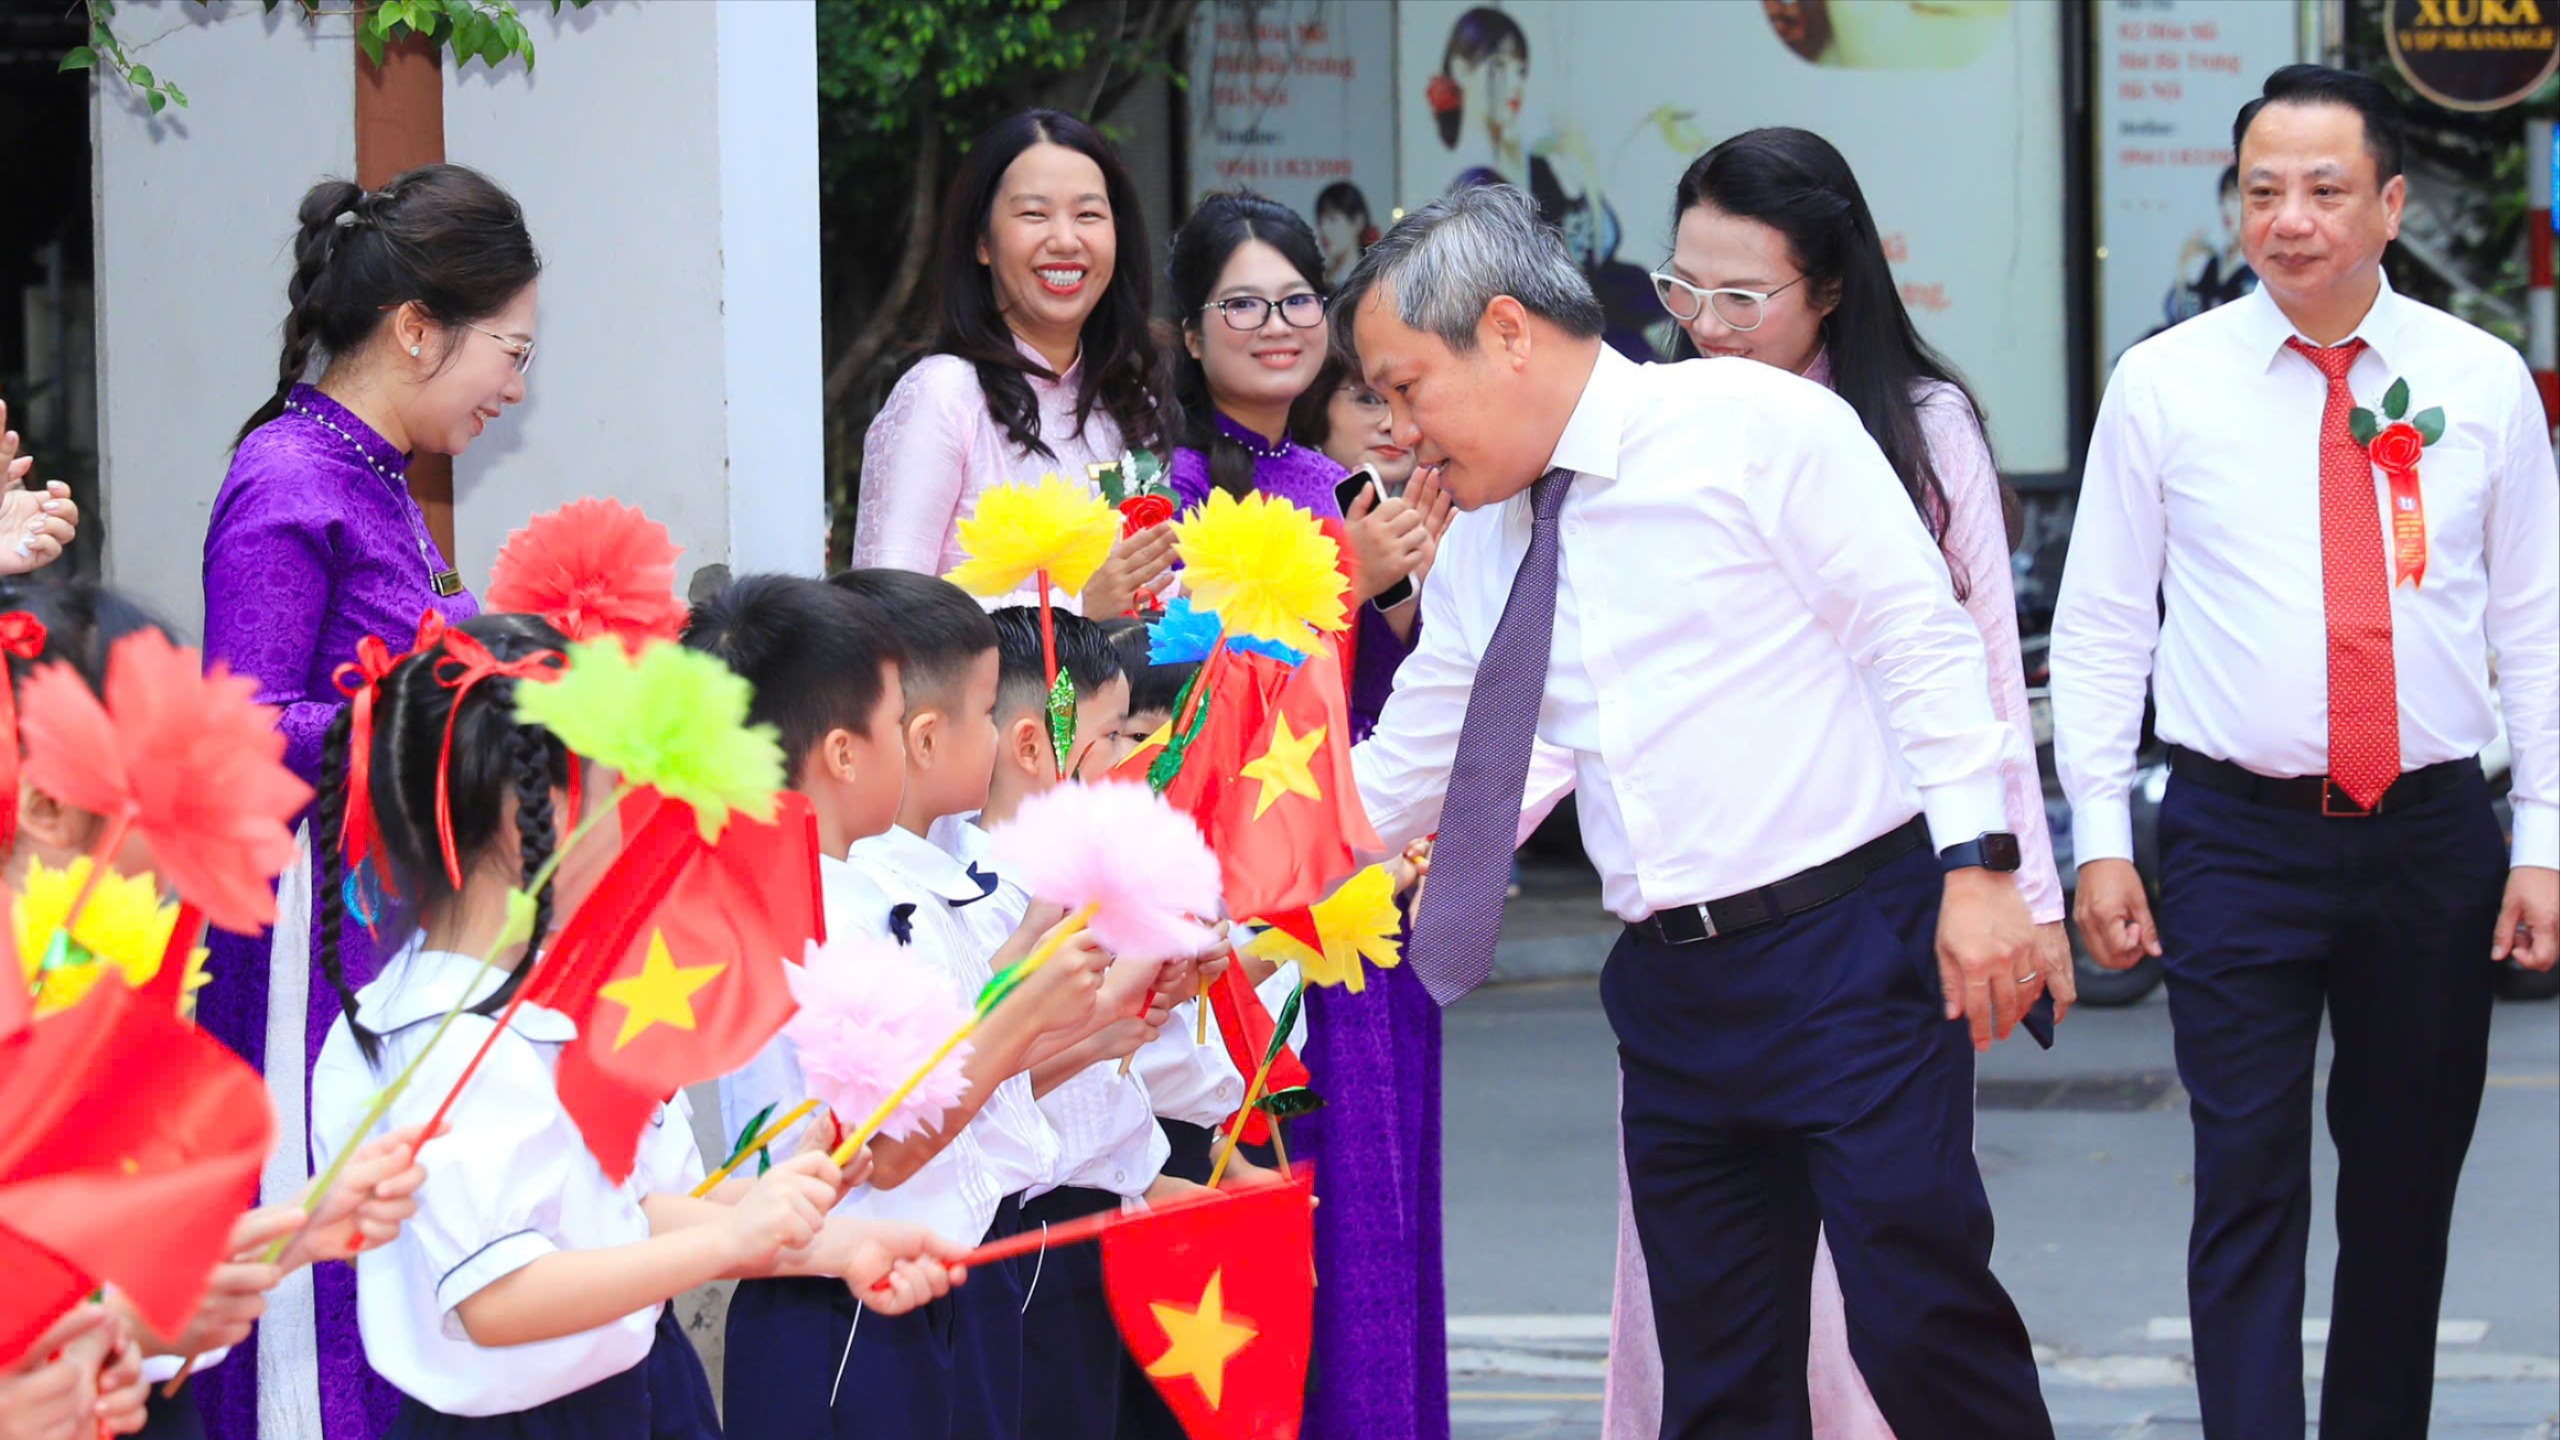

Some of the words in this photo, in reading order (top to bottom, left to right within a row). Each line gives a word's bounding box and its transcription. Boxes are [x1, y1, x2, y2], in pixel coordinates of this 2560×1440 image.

[2414, 0, 2542, 26] XUKA
[2399, 29, 2438, 51] VIP
[2444, 27, 2553, 50] MASSAGE
